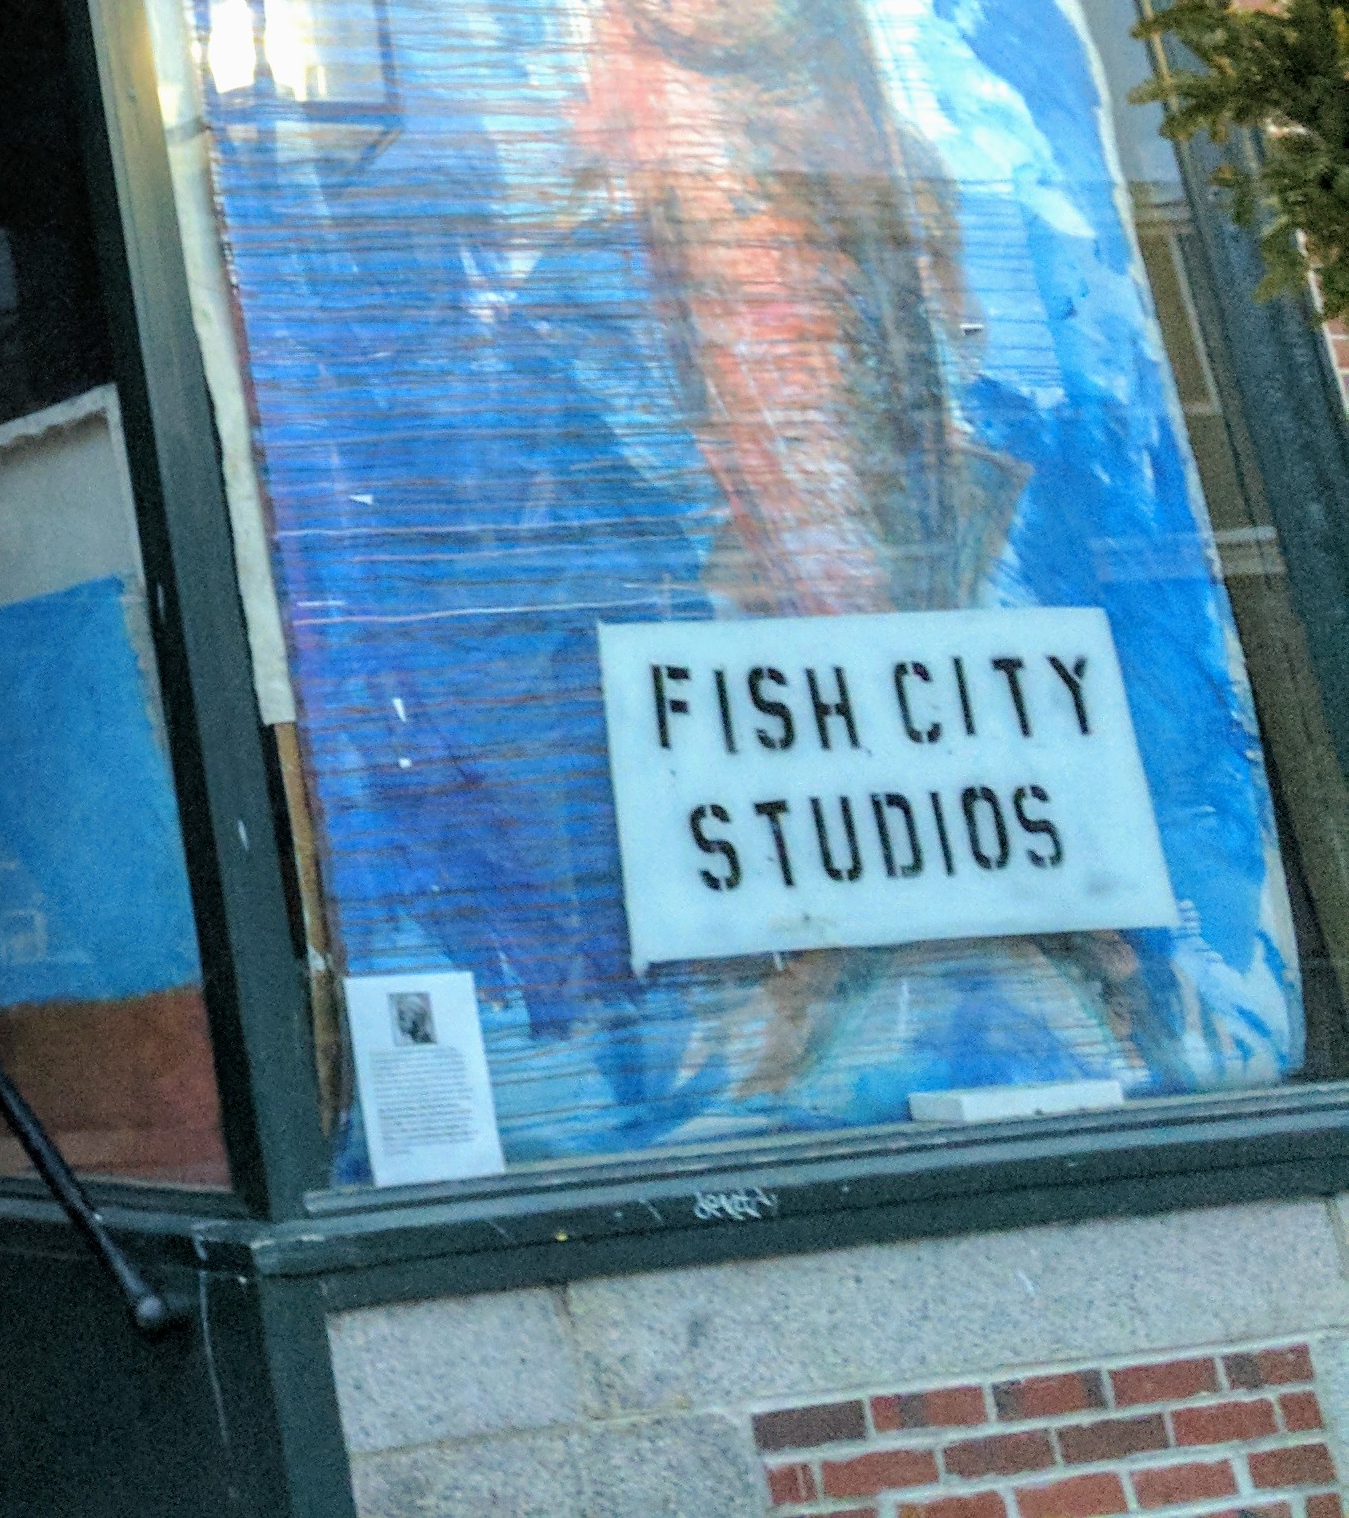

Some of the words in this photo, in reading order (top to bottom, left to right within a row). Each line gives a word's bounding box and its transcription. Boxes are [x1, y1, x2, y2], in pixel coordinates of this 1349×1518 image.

[649, 663, 863, 755] FISH
[894, 655, 1093, 746] CITY
[689, 784, 1066, 893] STUDIOS
